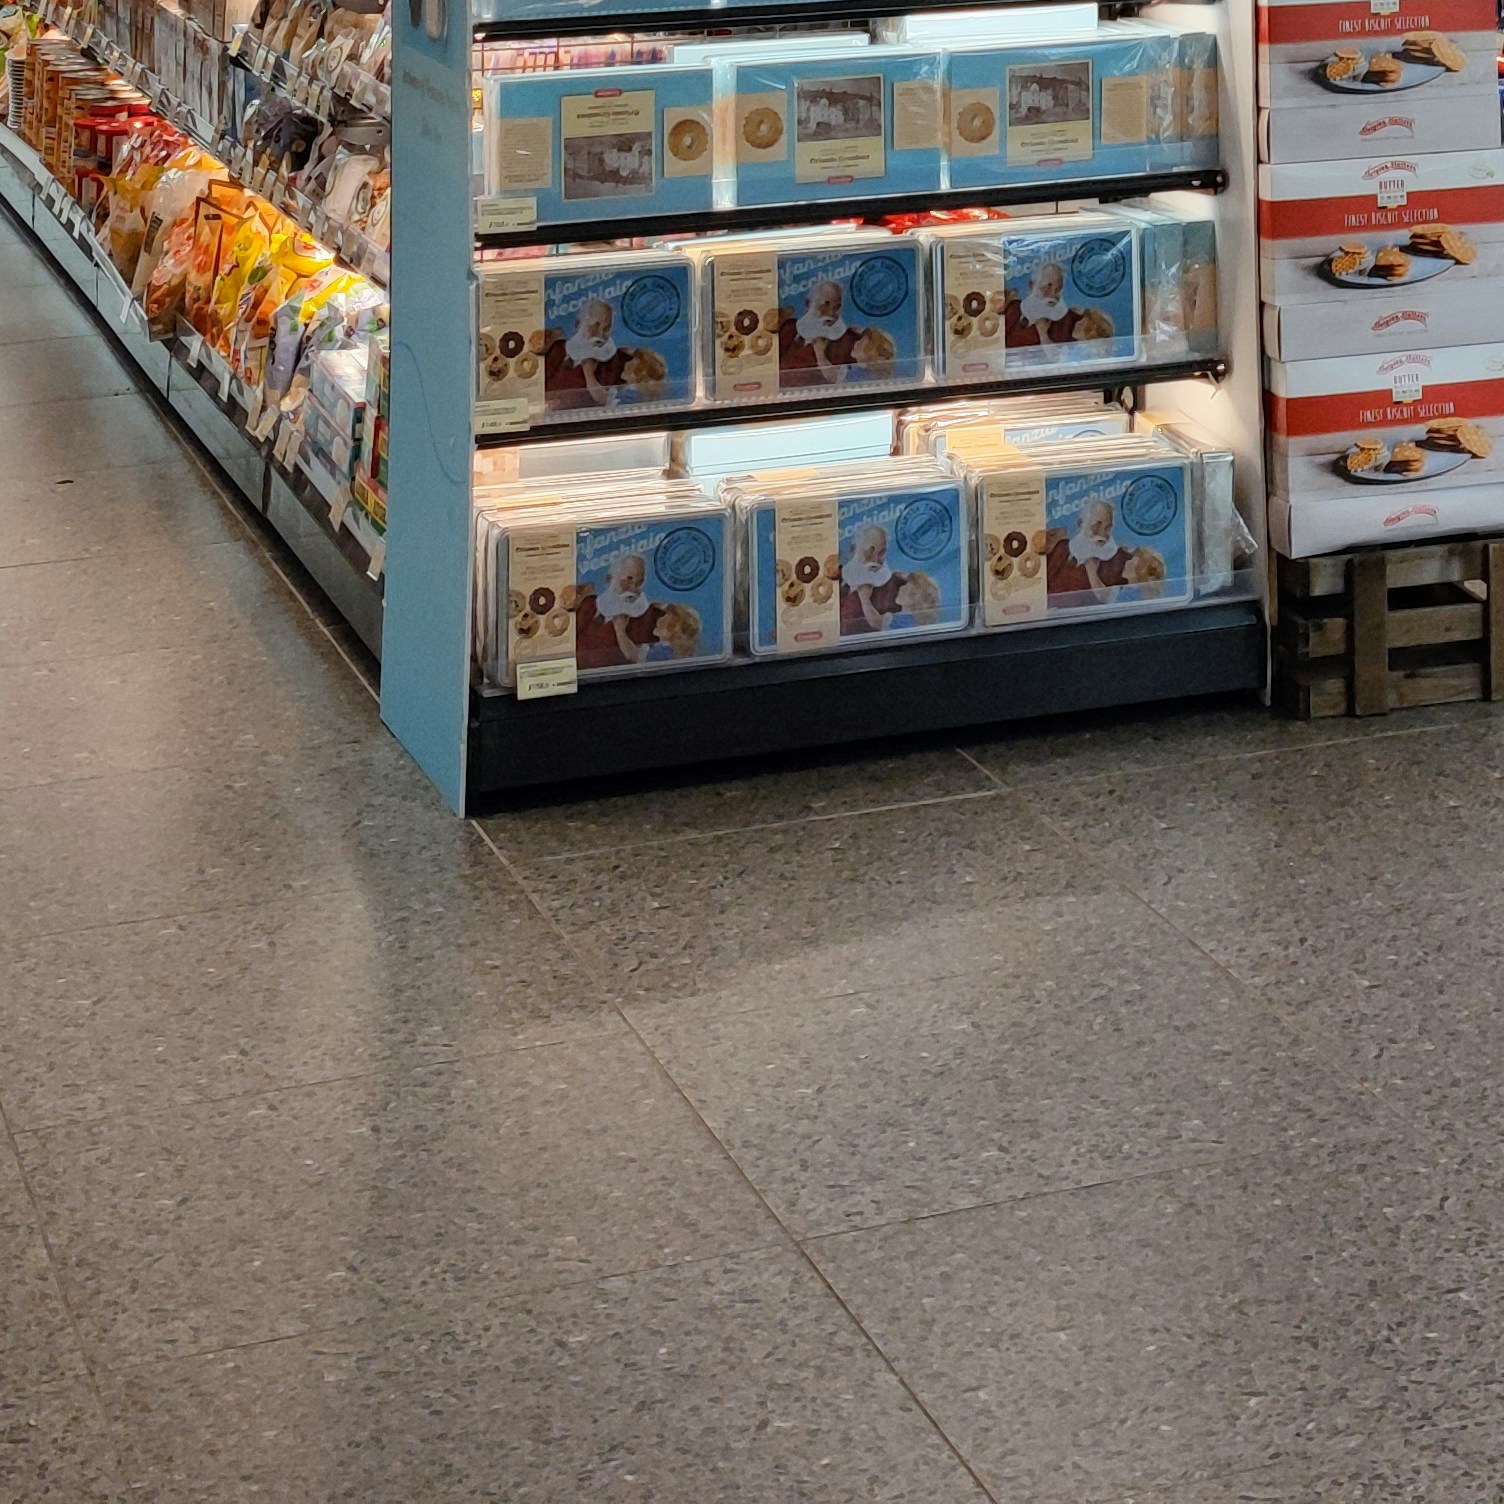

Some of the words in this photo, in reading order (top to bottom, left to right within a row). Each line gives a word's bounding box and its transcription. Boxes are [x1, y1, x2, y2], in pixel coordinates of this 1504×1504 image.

[1394, 15, 1429, 29] SELECTION
[1402, 208, 1438, 223] SELECTION
[1418, 403, 1454, 417] SELECTION
